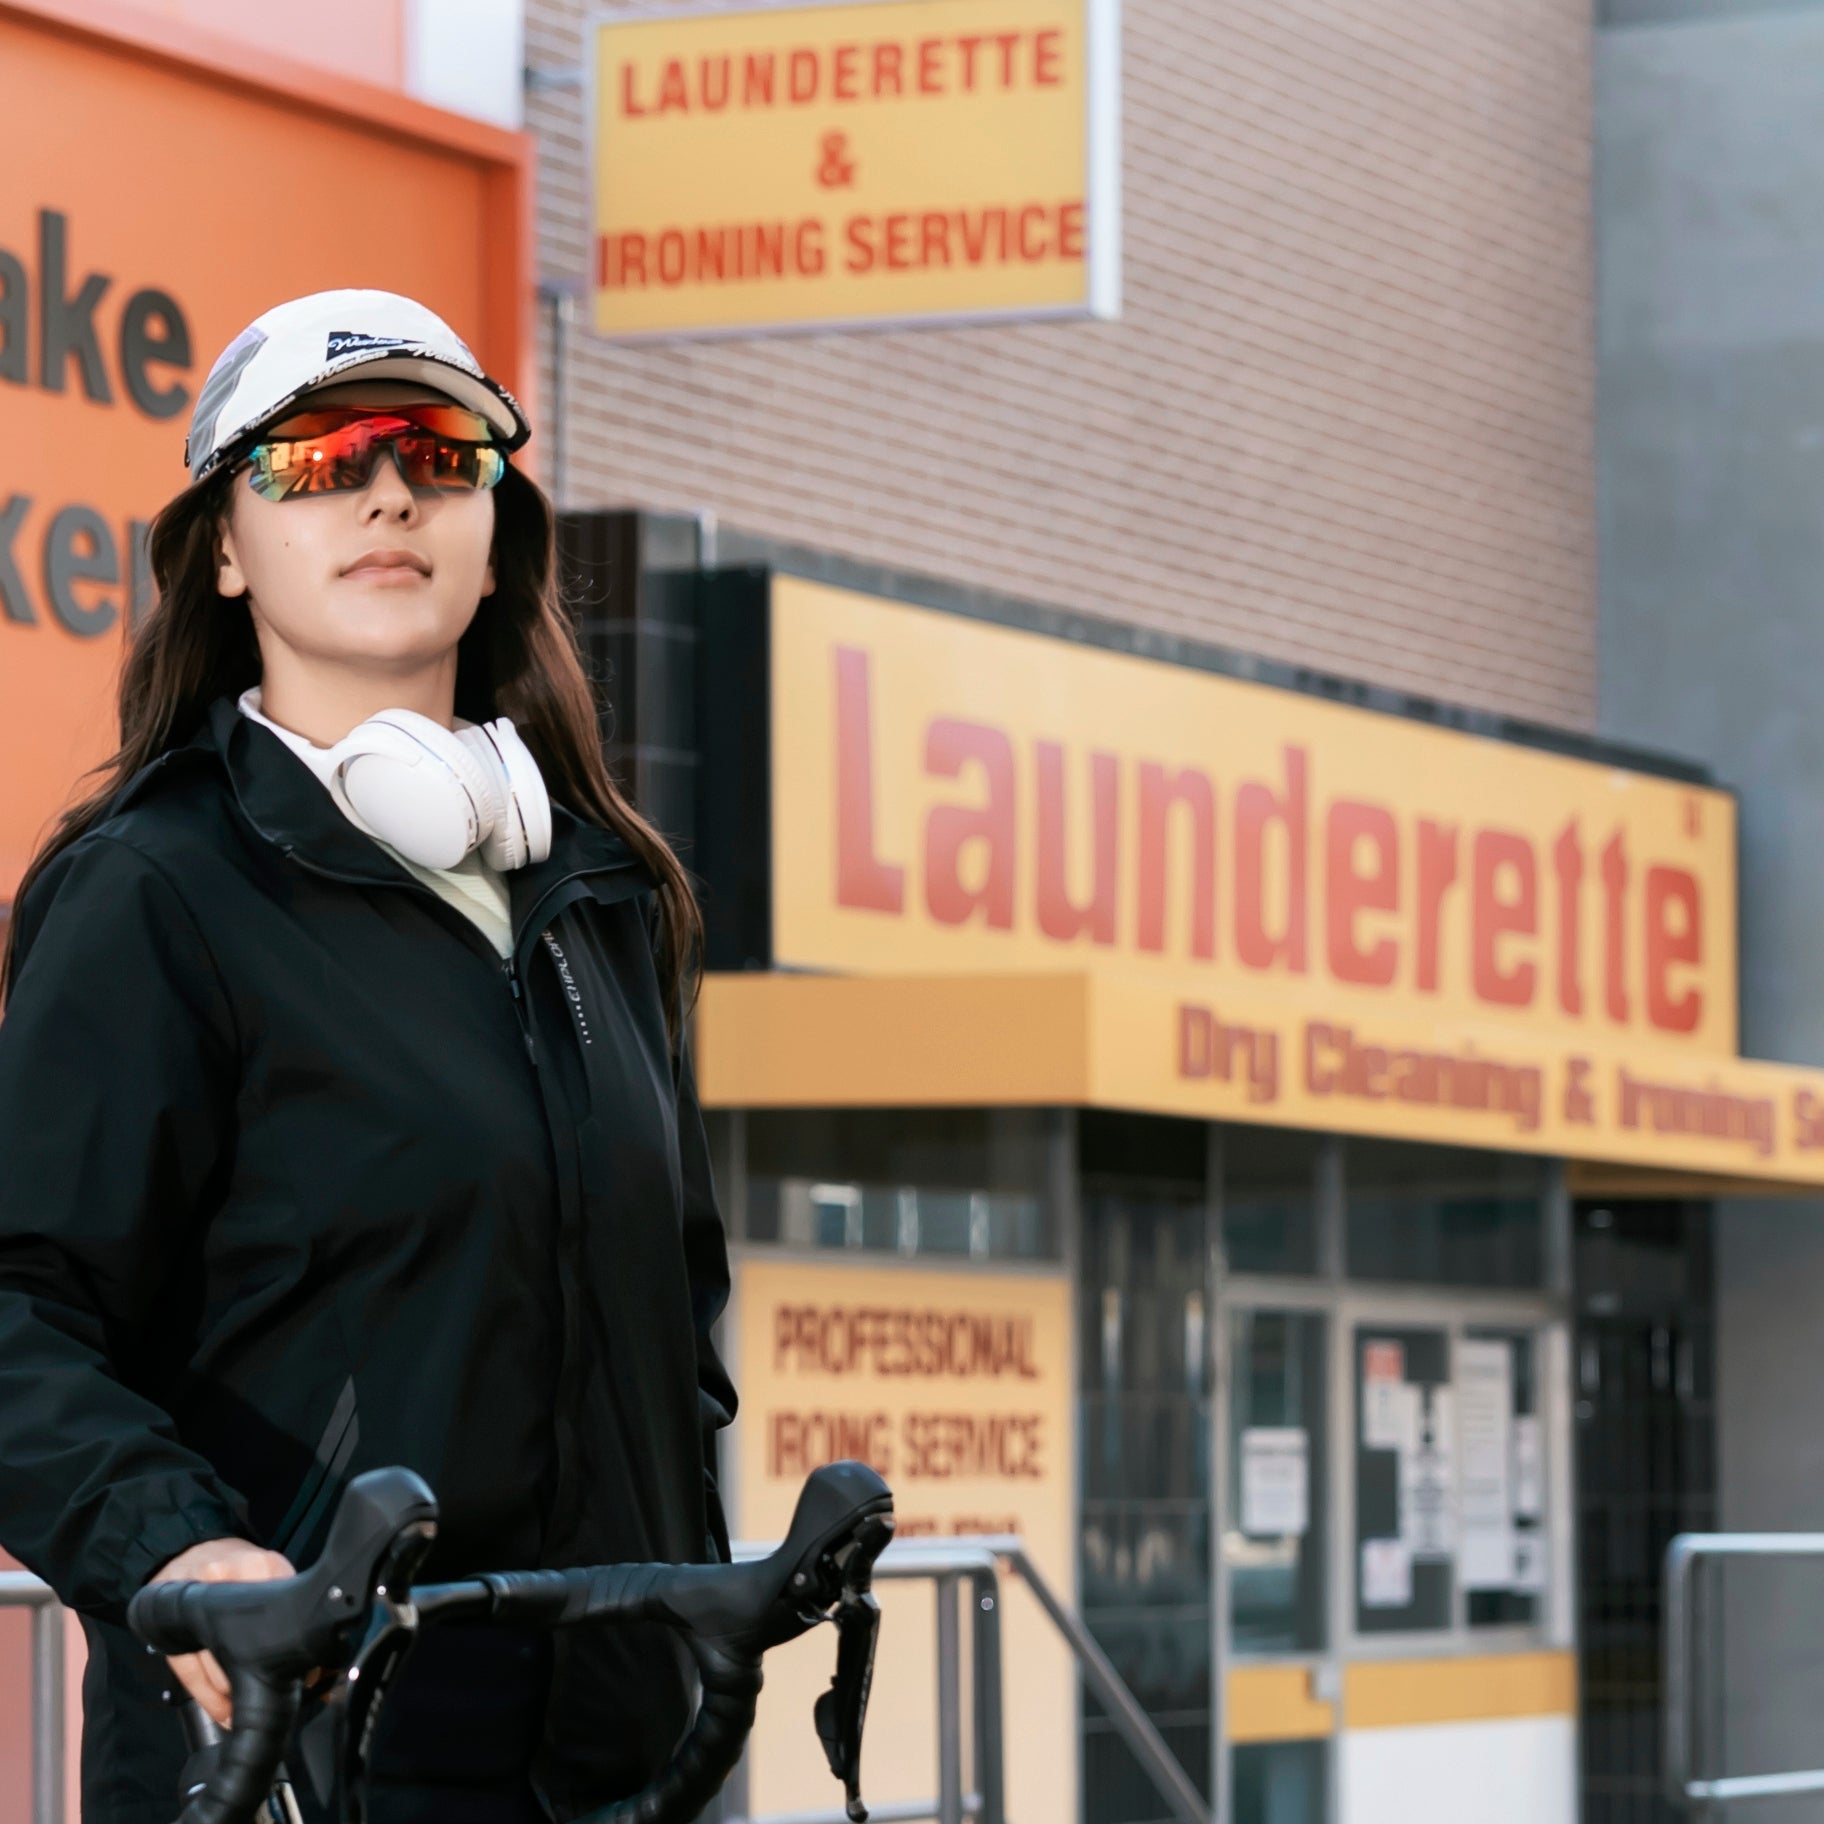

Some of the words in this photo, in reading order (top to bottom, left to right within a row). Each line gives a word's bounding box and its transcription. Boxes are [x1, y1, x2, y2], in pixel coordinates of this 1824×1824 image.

[619, 27, 1066, 119] LAUNDERETTE
[814, 129, 857, 190] &
[596, 219, 828, 292] IRONING
[843, 200, 1087, 276] SERVICE
[833, 642, 1706, 1037] Launderette
[1178, 1003, 1281, 1104] Dry
[1304, 1019, 1544, 1133] Cleaning
[1564, 1056, 1595, 1124] &
[772, 1300, 1043, 1381] PROFESSIONAL
